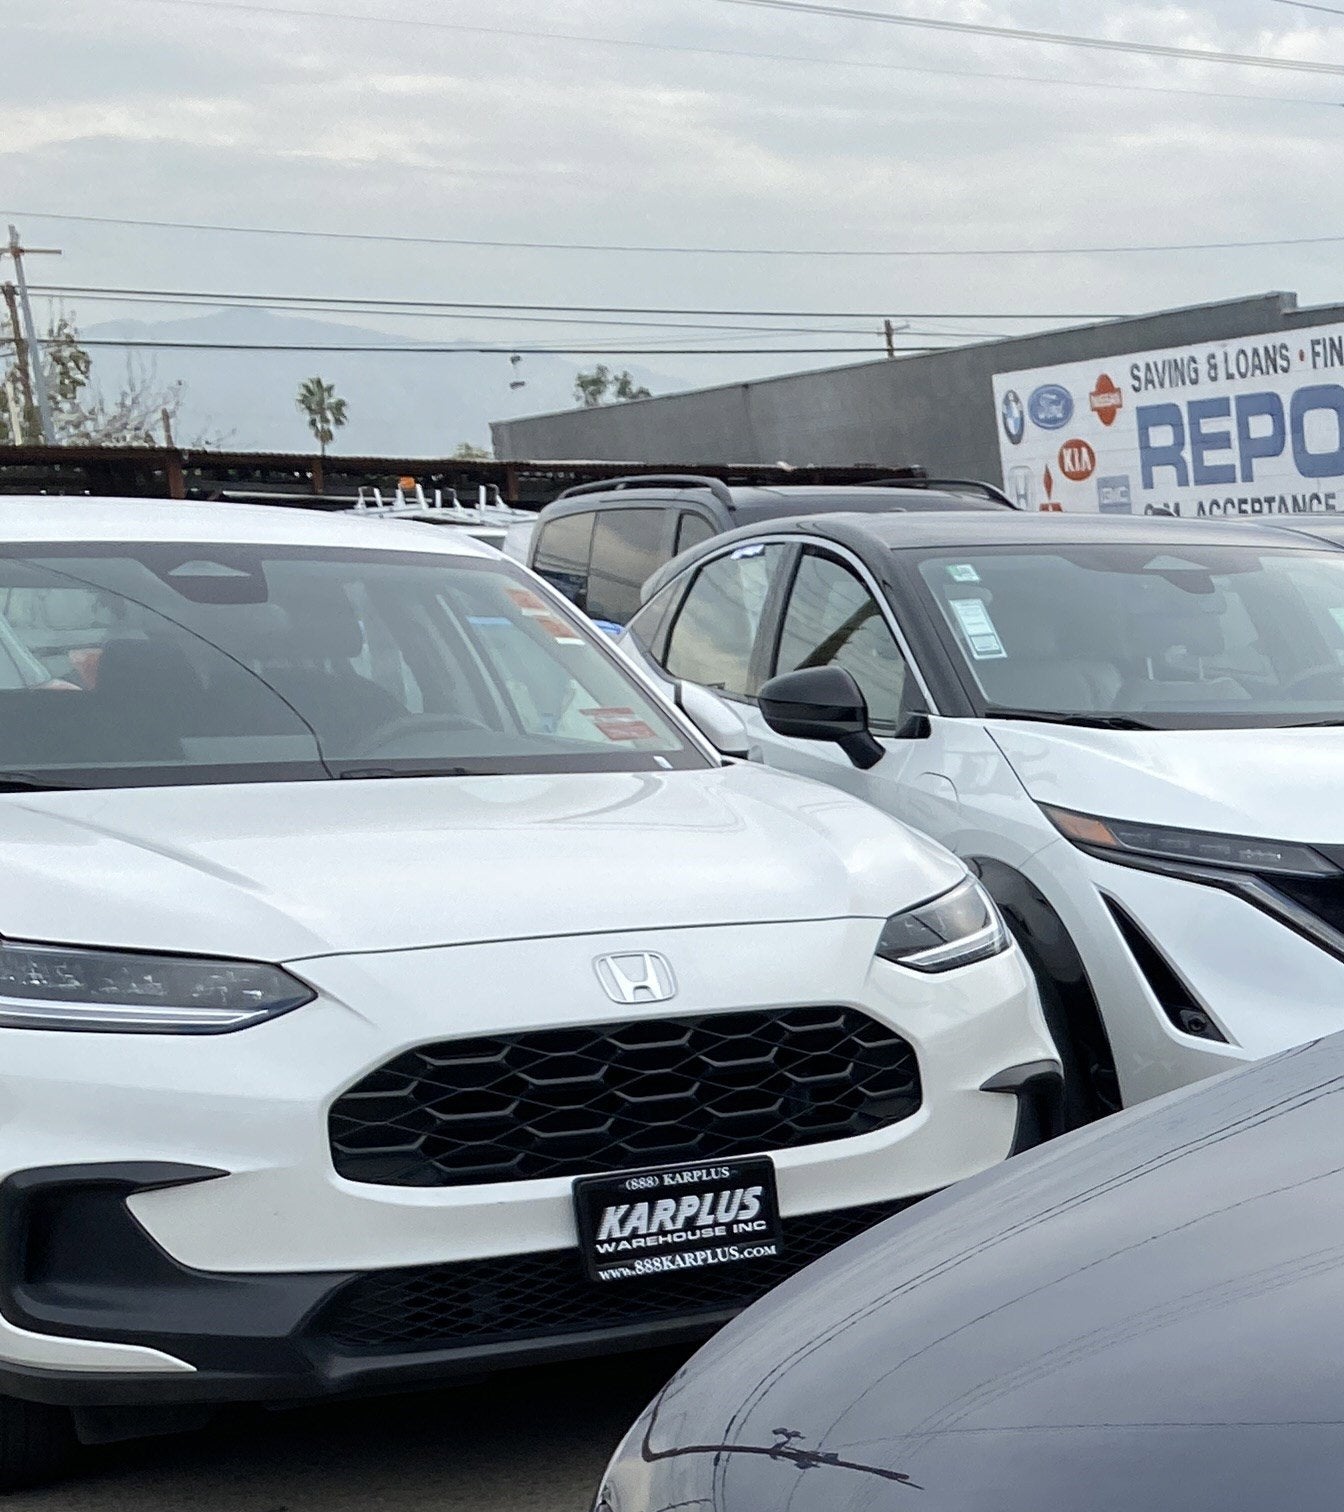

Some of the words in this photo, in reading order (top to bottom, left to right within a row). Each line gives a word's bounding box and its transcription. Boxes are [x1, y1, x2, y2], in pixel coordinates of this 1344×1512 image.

[1130, 354, 1199, 392] SAVING
[1208, 350, 1218, 381] &
[1225, 343, 1290, 379] LOANS
[1062, 446, 1093, 473] KIA
[625, 1176, 660, 1191] (888)
[663, 1166, 731, 1186] KARPLUS
[596, 1186, 763, 1241] KARPLUS
[595, 1226, 727, 1254] WAREHOUSE
[732, 1220, 767, 1234] INC
